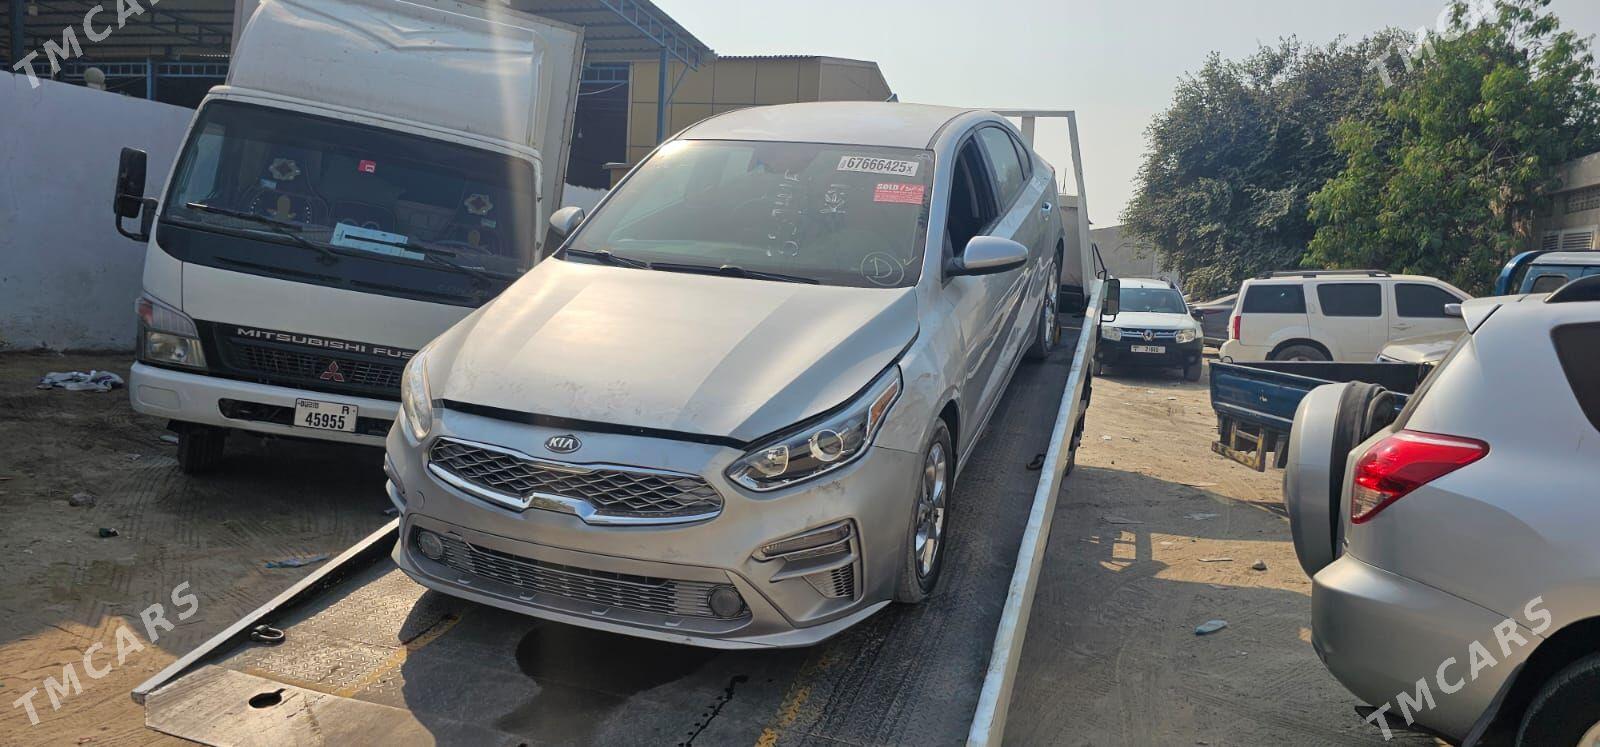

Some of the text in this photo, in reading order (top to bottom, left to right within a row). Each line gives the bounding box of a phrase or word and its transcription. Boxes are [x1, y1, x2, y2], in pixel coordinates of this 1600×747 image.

[237, 328, 415, 360] MITSUBISHI FUS
[341, 405, 350, 415] R
[305, 411, 346, 430] 45955
[549, 437, 574, 449] KIA
